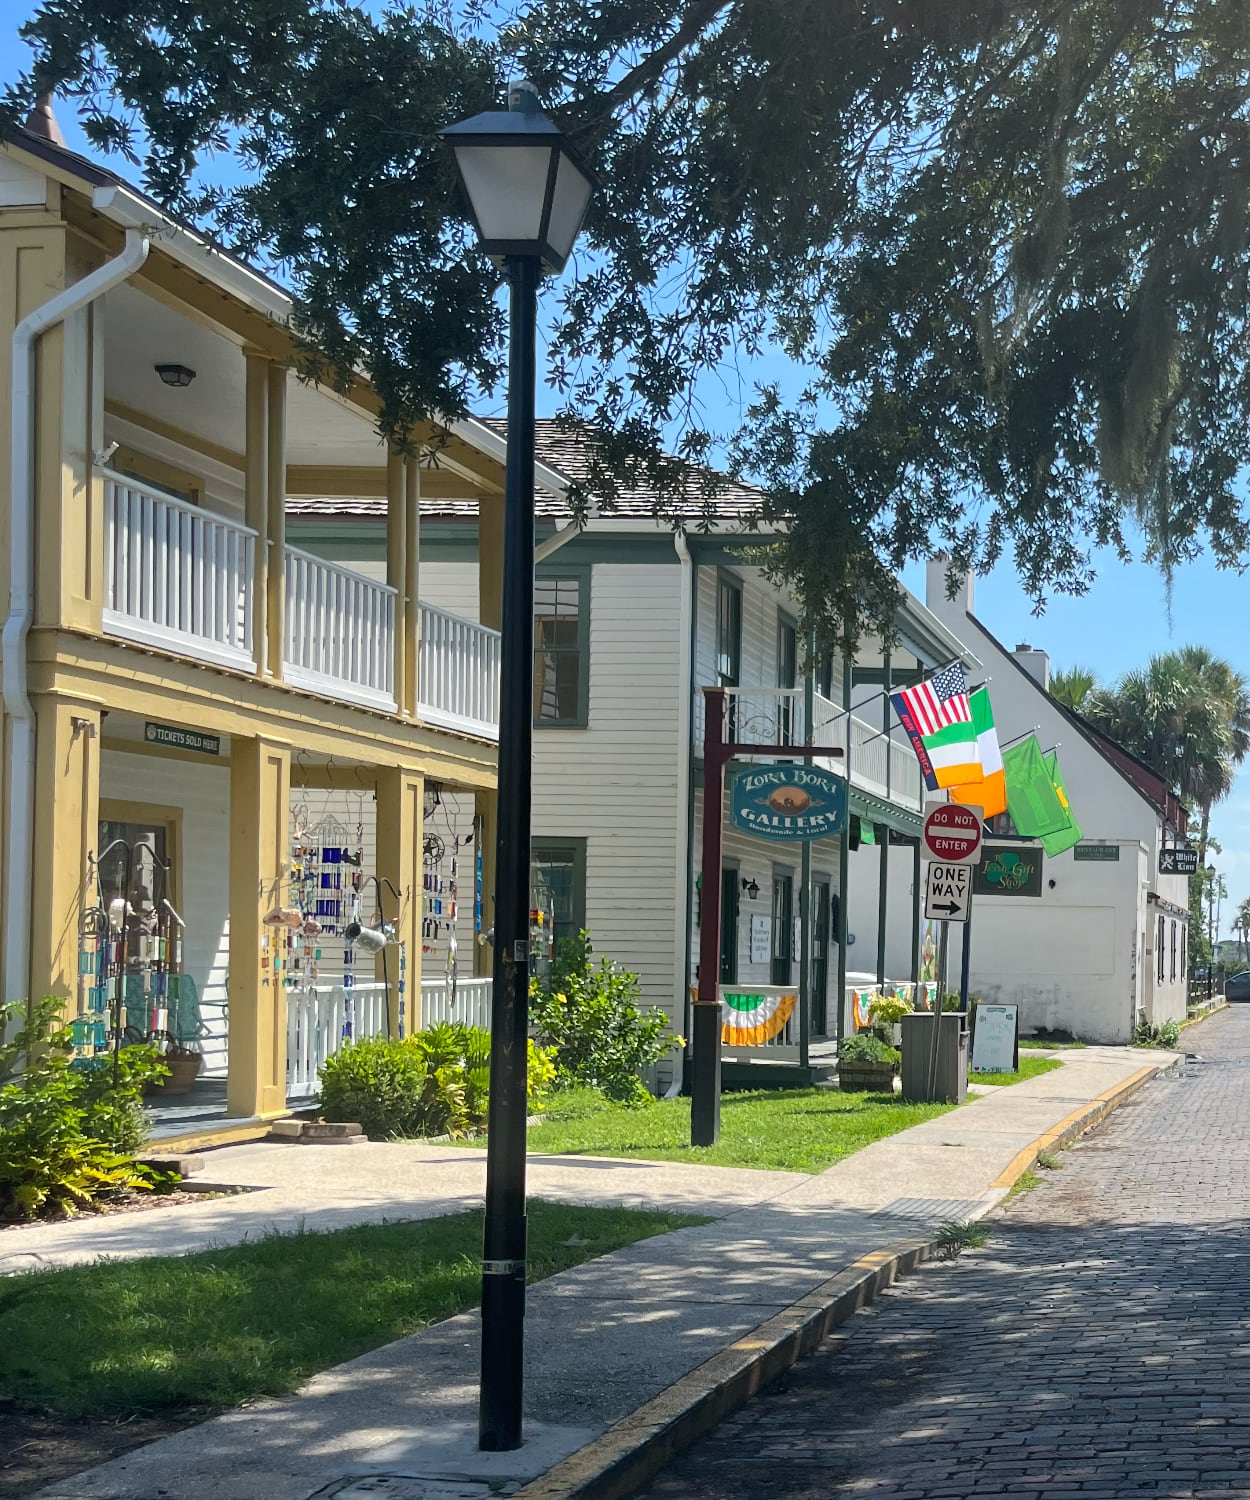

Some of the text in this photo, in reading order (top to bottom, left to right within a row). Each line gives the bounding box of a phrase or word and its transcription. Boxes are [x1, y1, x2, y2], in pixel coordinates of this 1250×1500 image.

[157, 729, 219, 750] TICKETS SOLD HERE
[740, 808, 838, 828] GALLERY
[934, 813, 974, 826] DO NOT
[935, 839, 968, 852] ENTER
[1175, 852, 1197, 863] White
[1177, 861, 1196, 872] Lion
[933, 866, 967, 882] ONE
[932, 882, 966, 898] WAY
[997, 876, 1026, 890] Shop
